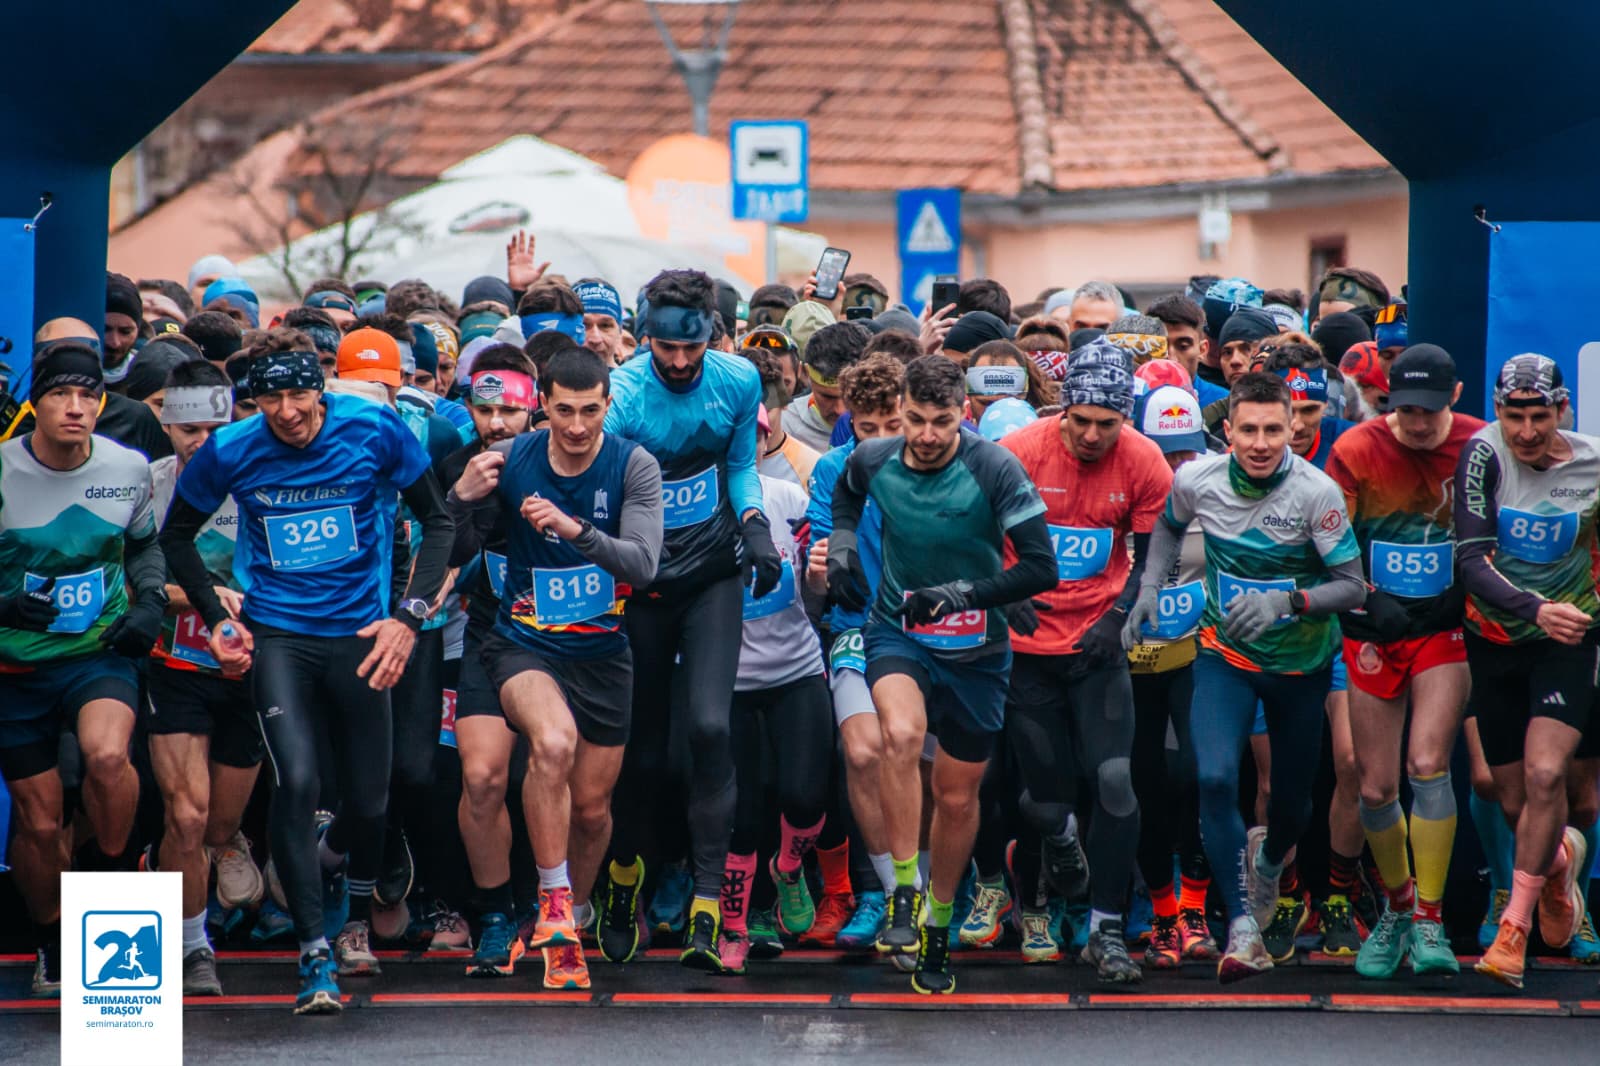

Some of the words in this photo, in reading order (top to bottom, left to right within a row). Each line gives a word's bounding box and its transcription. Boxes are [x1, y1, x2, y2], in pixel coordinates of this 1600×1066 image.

[49, 374, 96, 385] AFIT
[1159, 419, 1176, 429] Red
[1178, 418, 1192, 428] Bull
[1465, 441, 1494, 519] ADIZERO
[86, 486, 136, 499] datacor
[275, 486, 348, 504] FitClass
[662, 480, 707, 508] 202
[216, 513, 239, 526] data
[283, 516, 339, 545] 326
[1510, 517, 1562, 542] 851
[1386, 551, 1439, 574] 853
[48, 582, 92, 608] 66
[549, 572, 601, 600] 818
[1160, 592, 1193, 617] 09
[184, 614, 212, 642] 14
[932, 610, 982, 626] 25
[833, 633, 864, 655] 20
